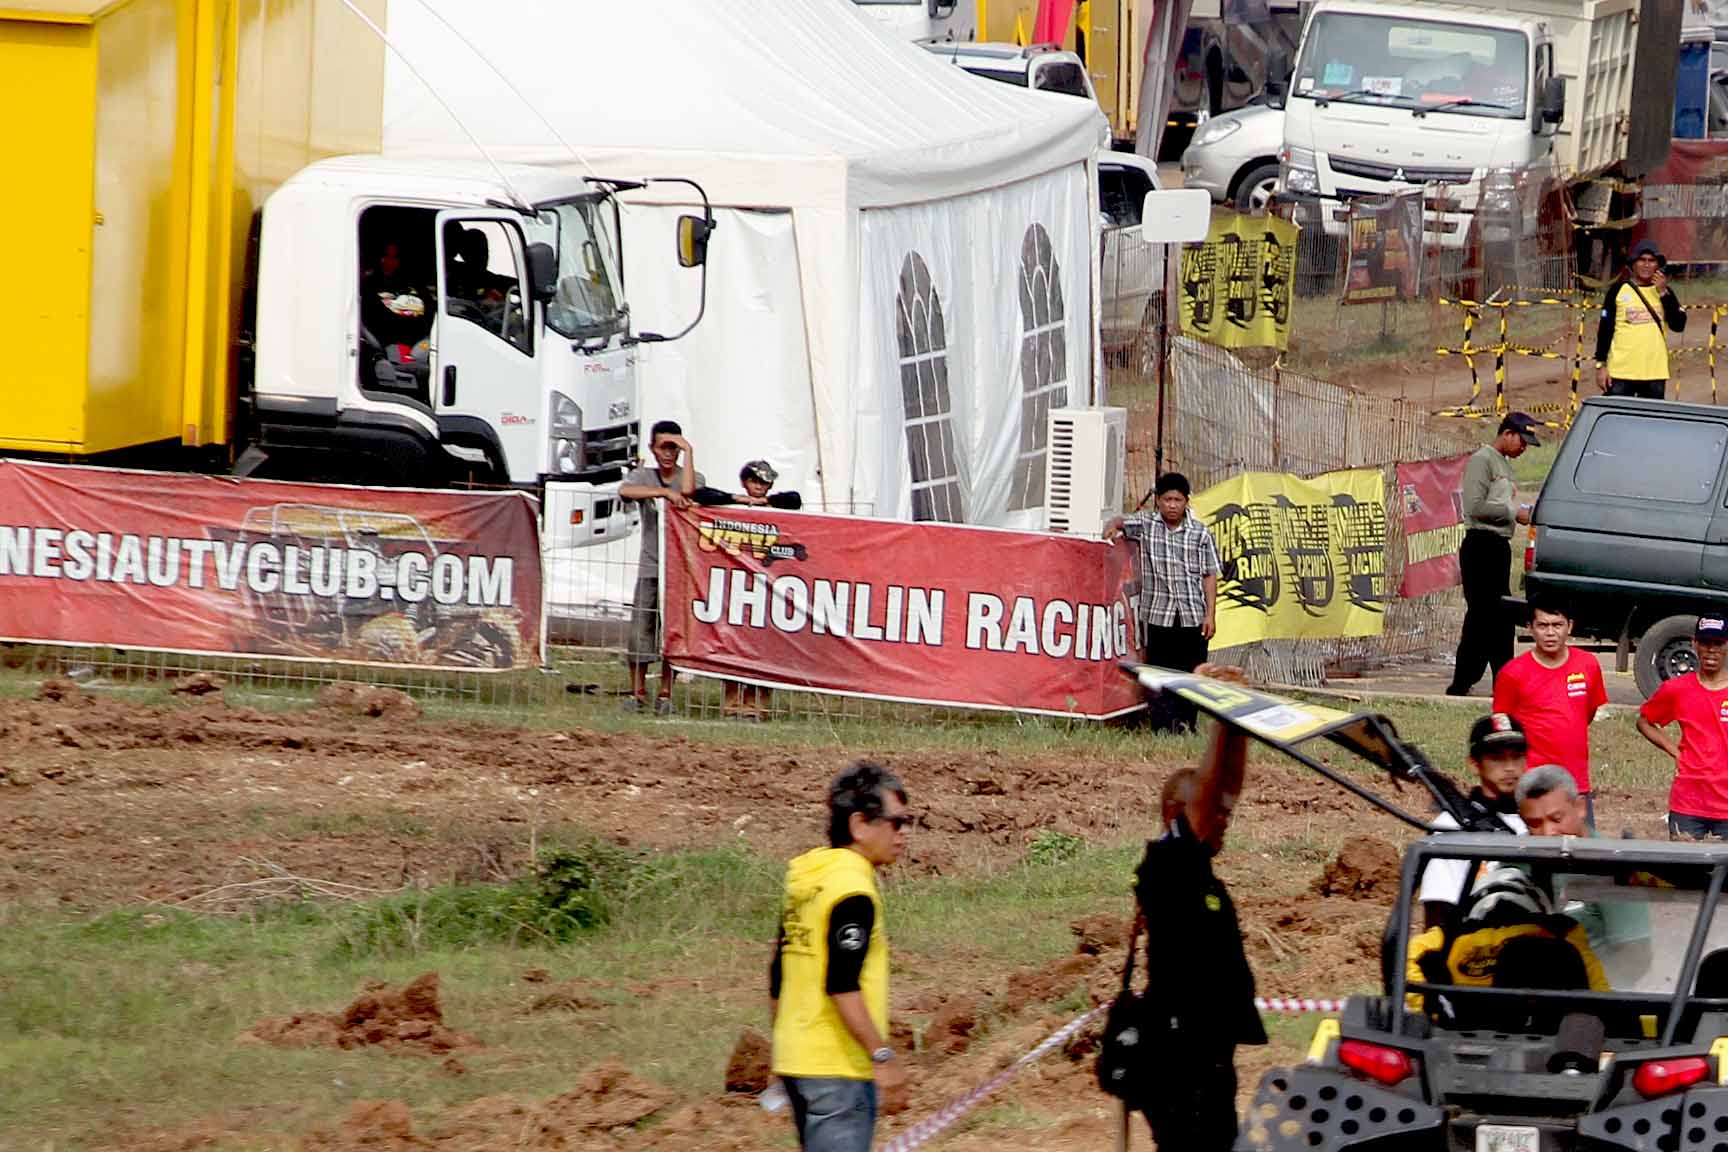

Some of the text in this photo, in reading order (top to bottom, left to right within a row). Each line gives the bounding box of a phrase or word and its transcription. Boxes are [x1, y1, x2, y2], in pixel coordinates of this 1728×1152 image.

[714, 519, 778, 535] INDONESIA
[770, 545, 795, 557] CLUB
[692, 566, 944, 645] JHONLIN
[966, 592, 1127, 661] RACING
